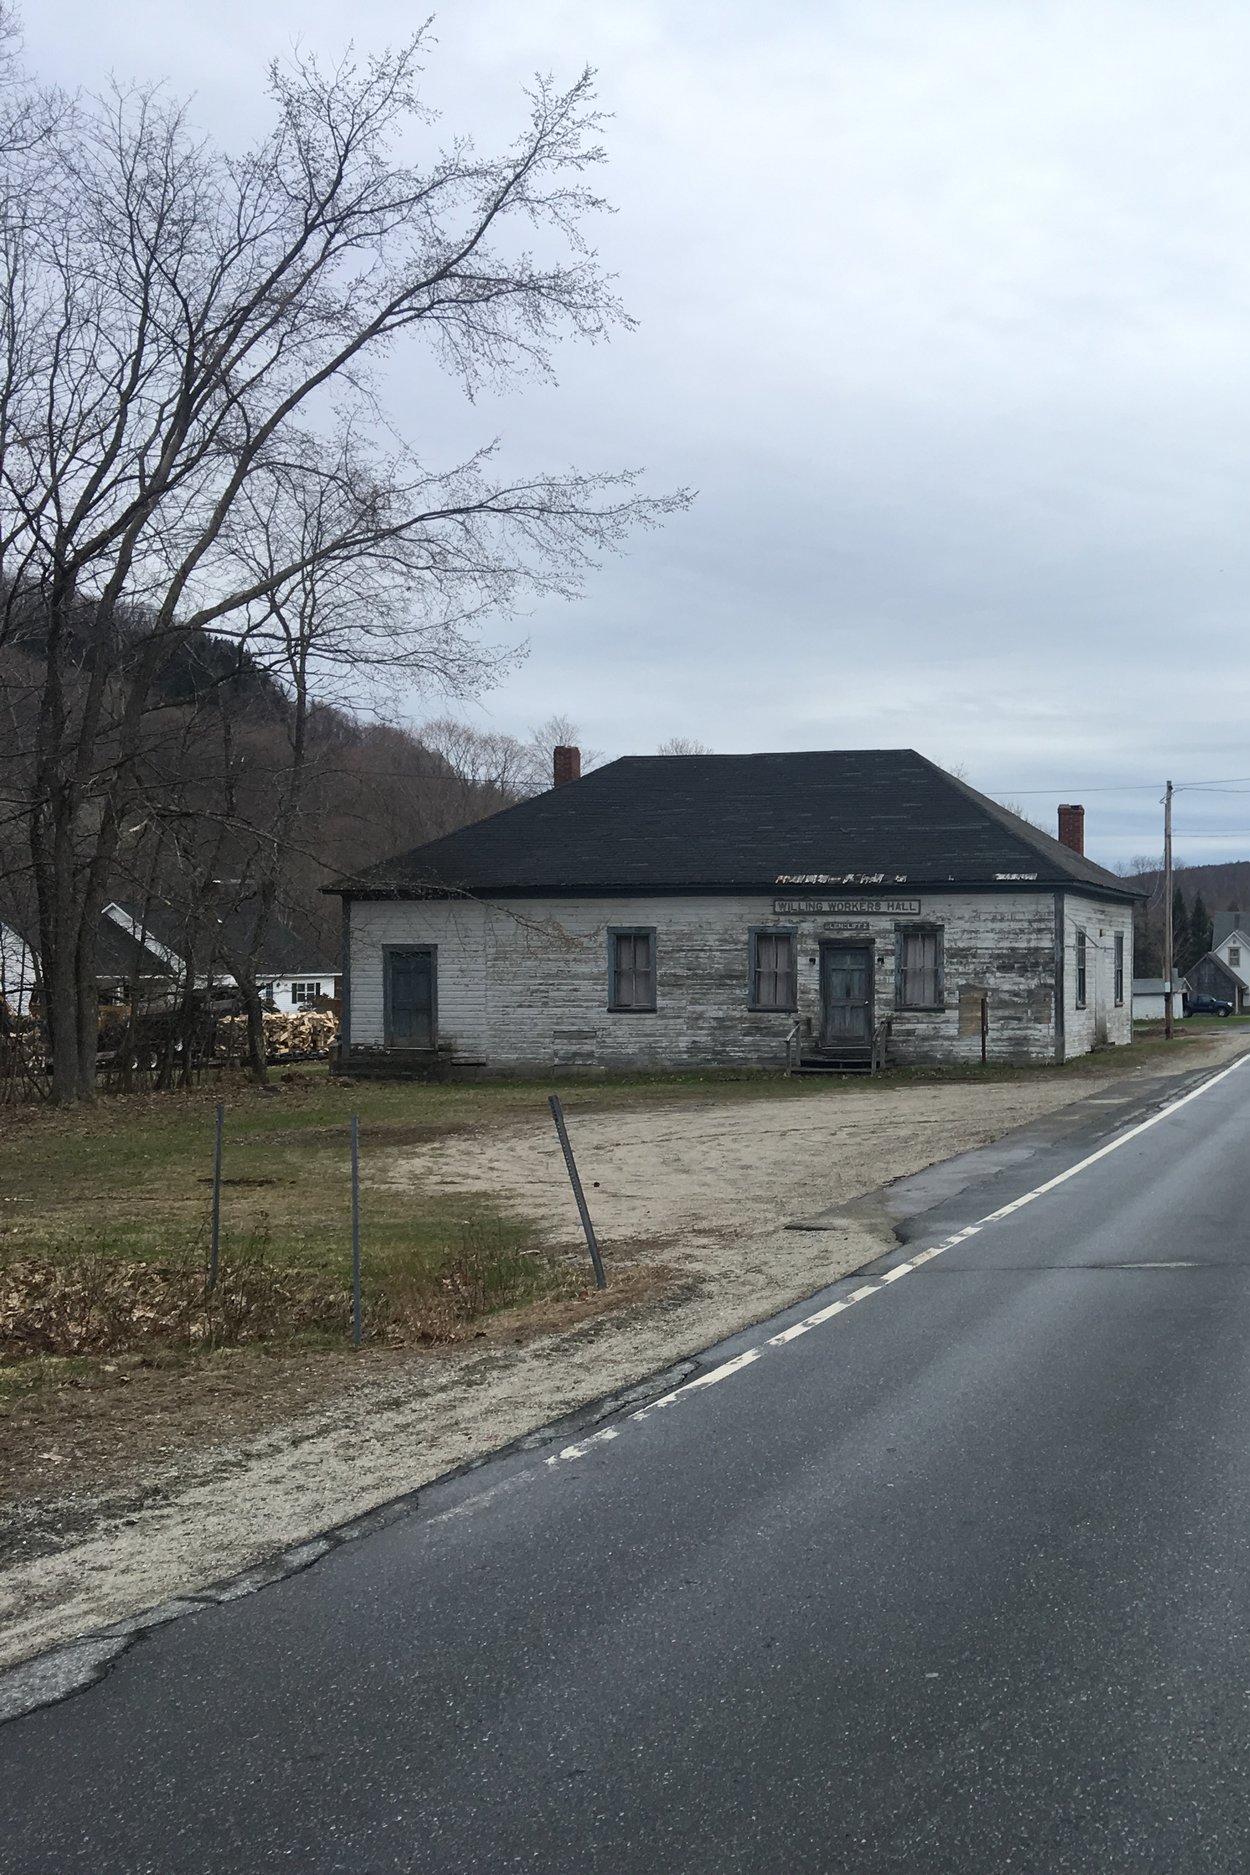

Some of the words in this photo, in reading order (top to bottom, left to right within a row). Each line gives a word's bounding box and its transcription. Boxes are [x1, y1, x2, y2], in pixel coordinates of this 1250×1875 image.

[777, 901, 823, 912] WILLING
[828, 901, 882, 912] WORKERS
[887, 901, 917, 912] HALL
